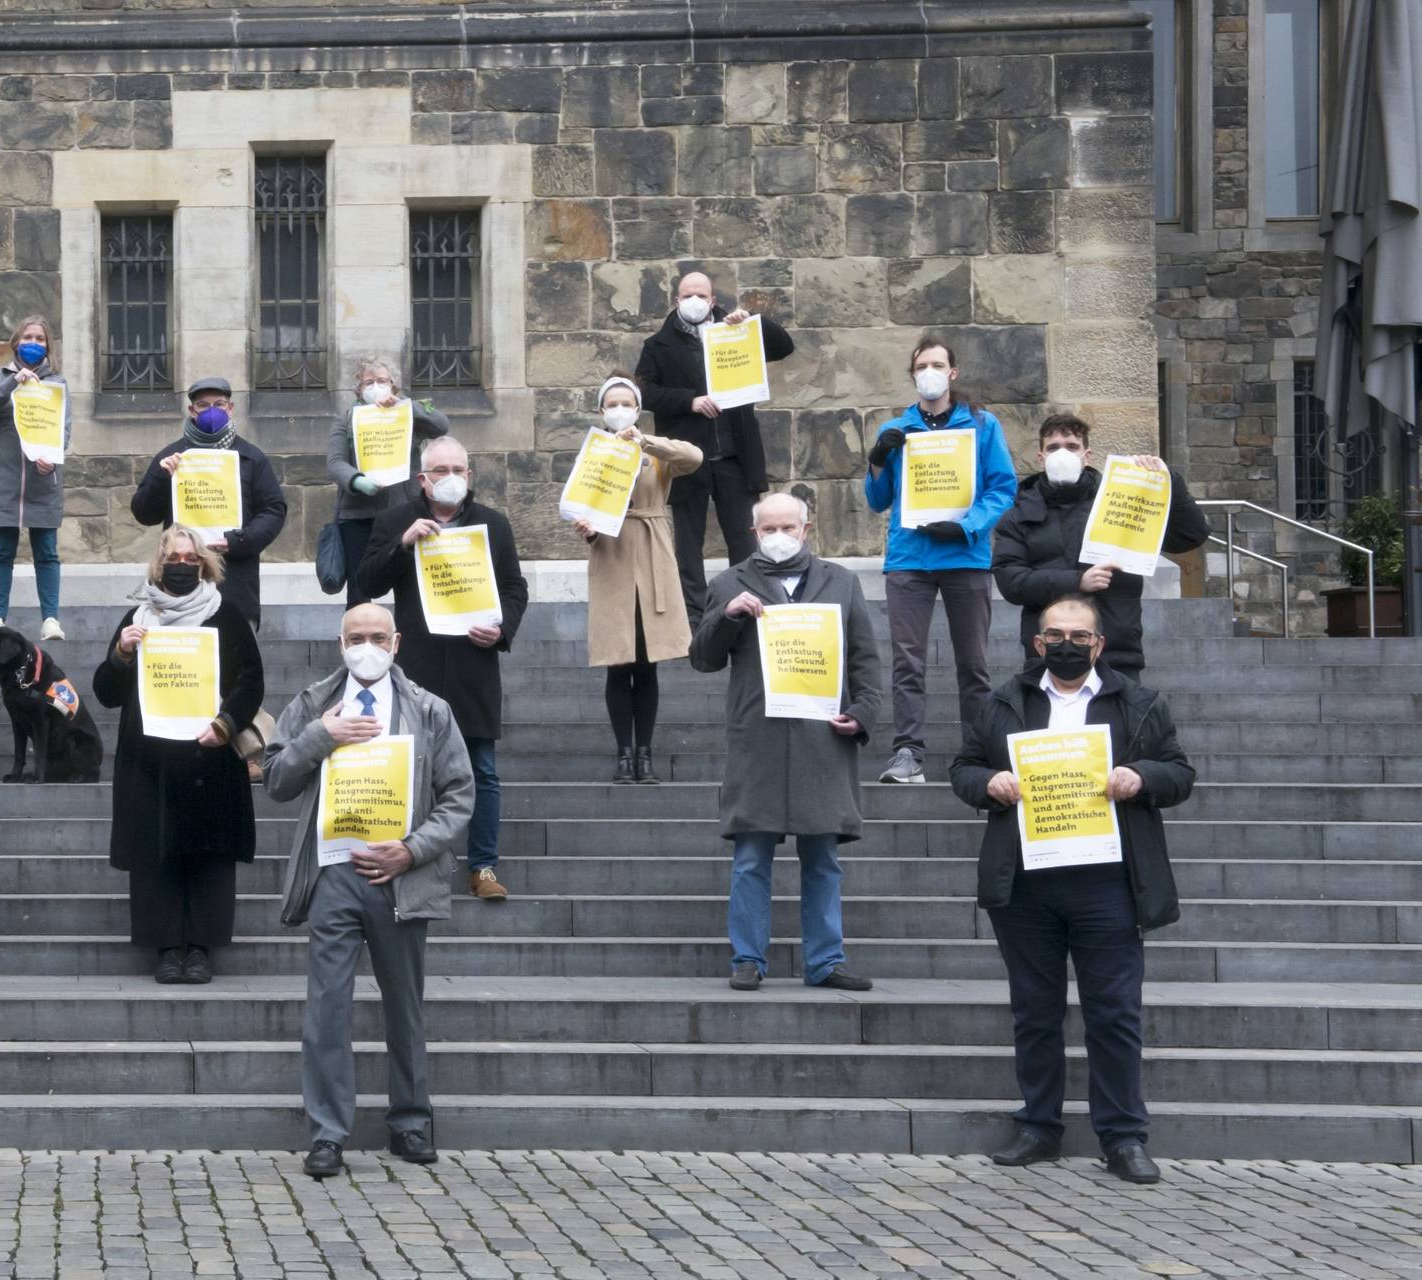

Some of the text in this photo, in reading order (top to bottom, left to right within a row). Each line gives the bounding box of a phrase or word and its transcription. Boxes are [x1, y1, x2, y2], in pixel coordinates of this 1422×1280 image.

[776, 648, 823, 658] Entlastung
[778, 666, 826, 675] heitswesens
[153, 672, 197, 680] Akzeptanz
[335, 778, 362, 786] Gegen
[1029, 773, 1058, 783] Gegen
[1034, 804, 1052, 813] und
[334, 817, 402, 826] demokratisches
[1035, 811, 1106, 824] demokratisches
[334, 826, 370, 835] Handeln
[1036, 824, 1077, 834] Handeln
